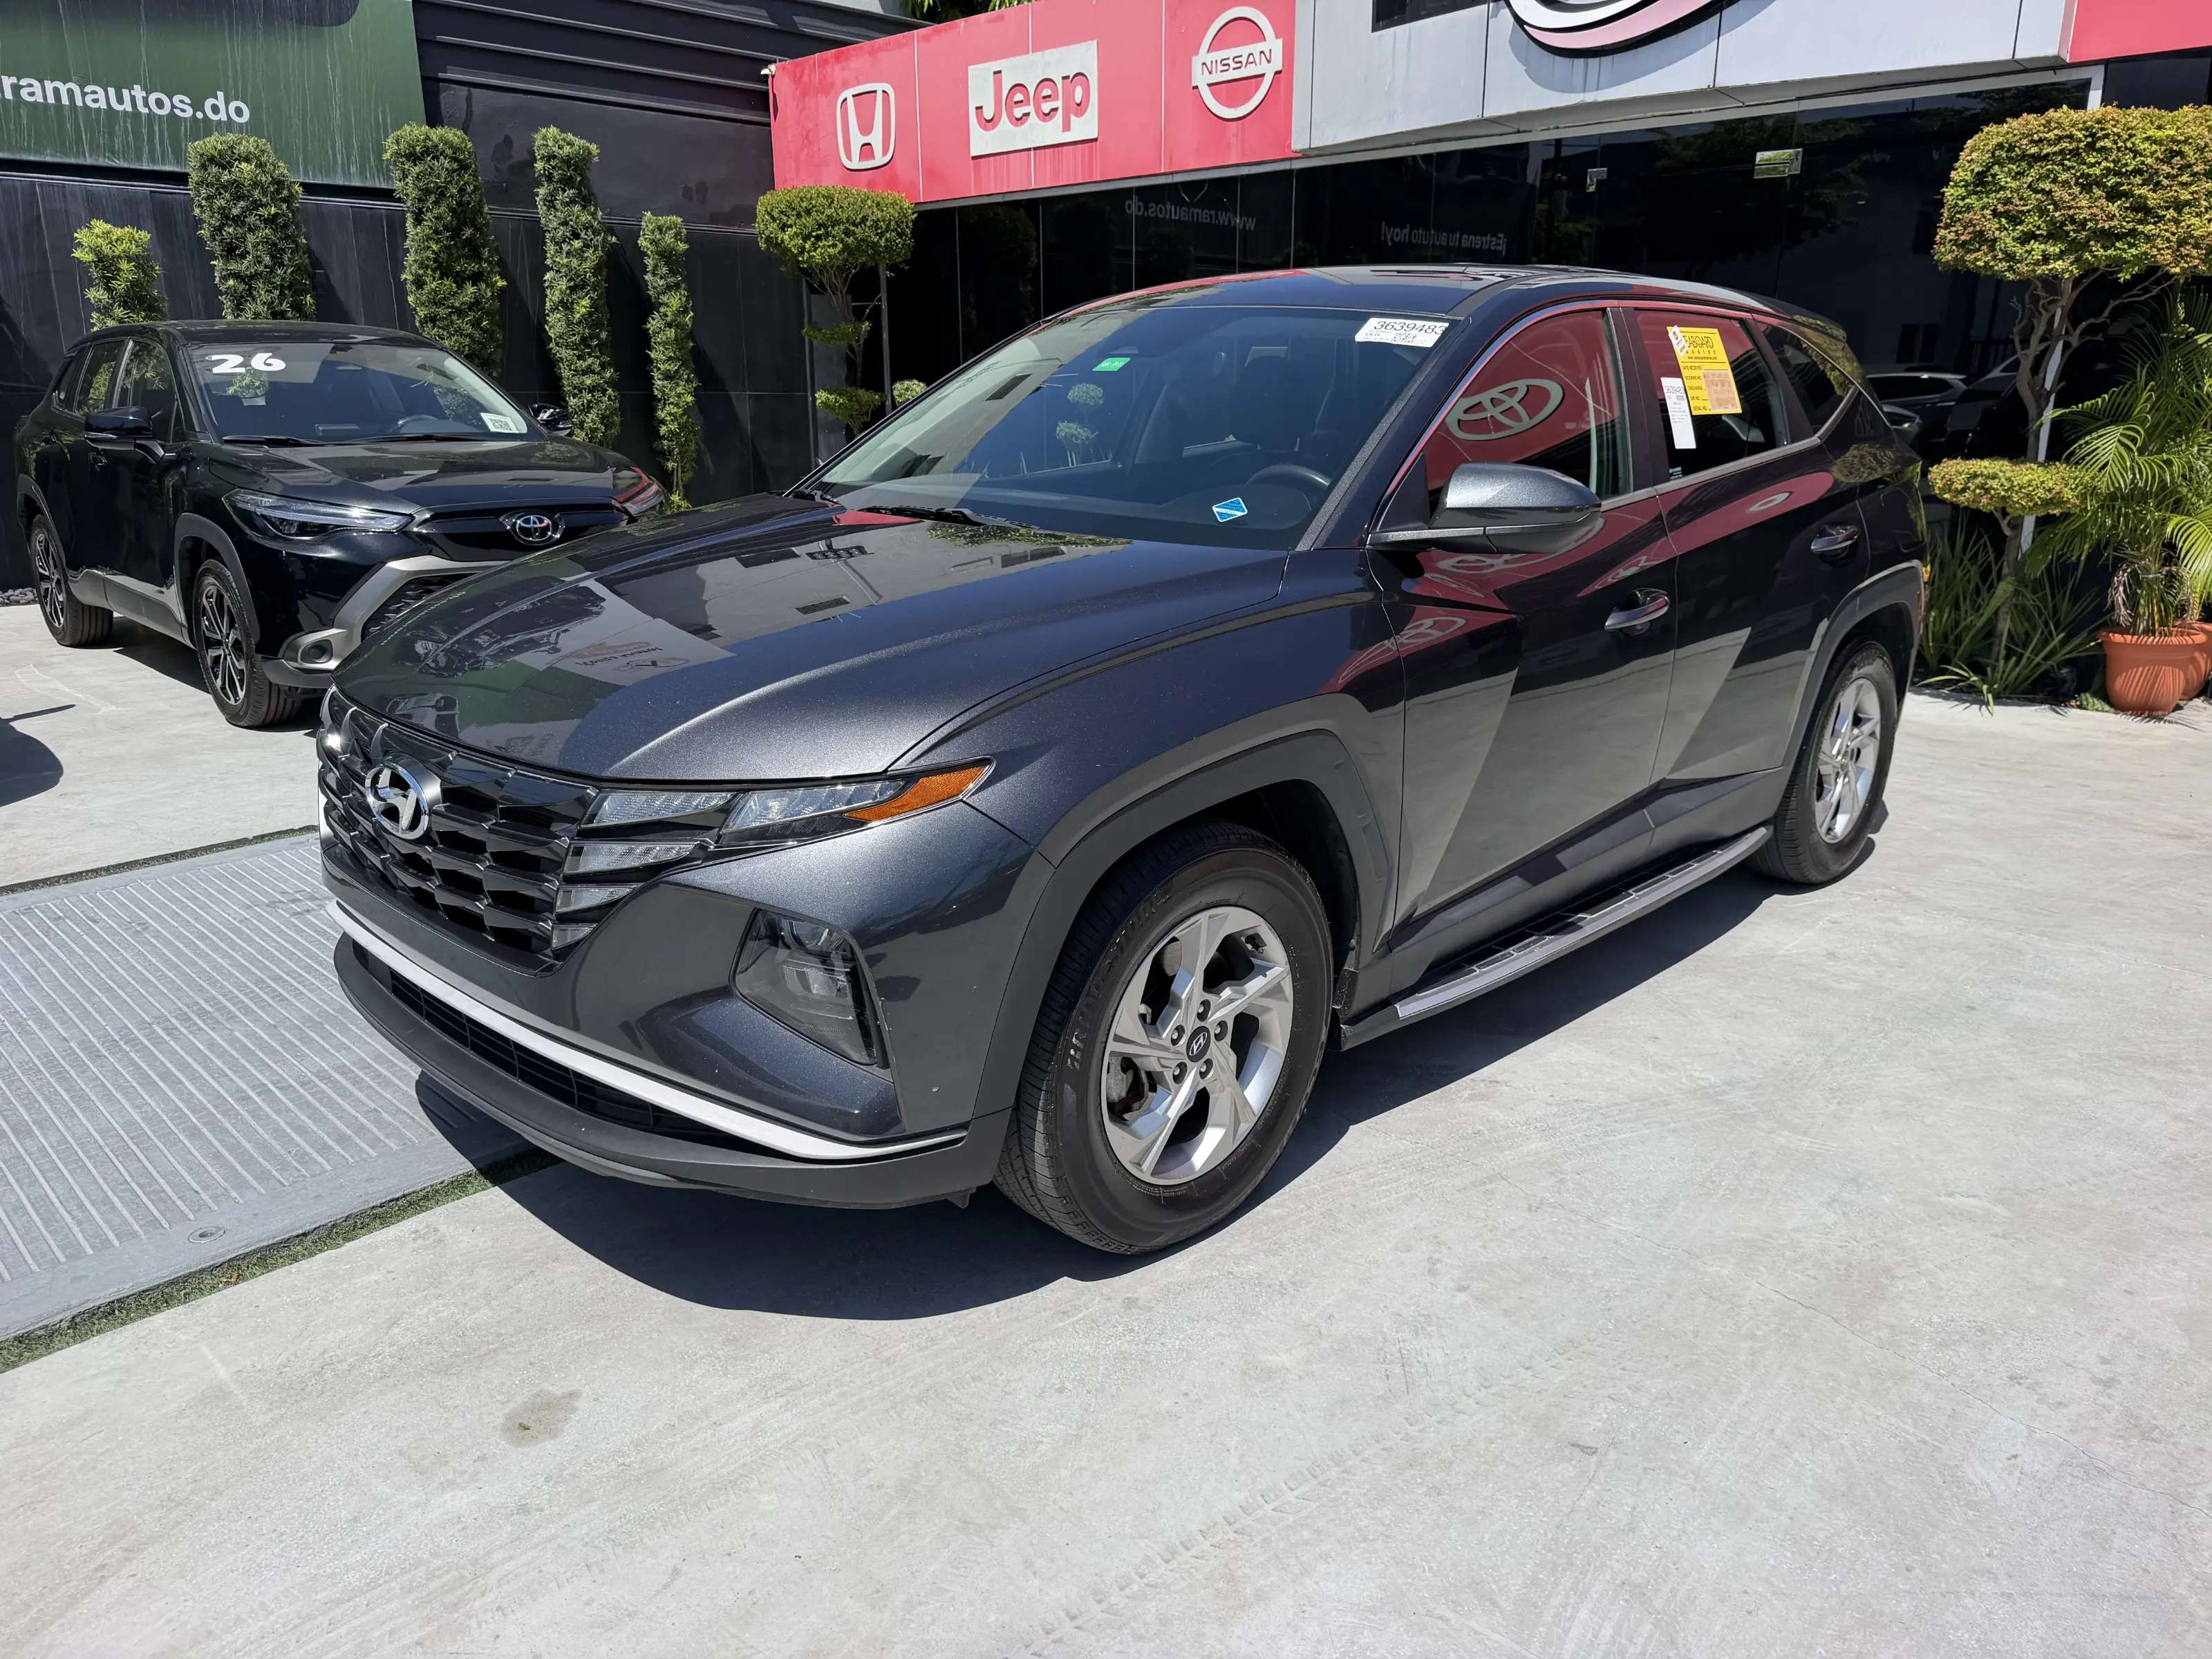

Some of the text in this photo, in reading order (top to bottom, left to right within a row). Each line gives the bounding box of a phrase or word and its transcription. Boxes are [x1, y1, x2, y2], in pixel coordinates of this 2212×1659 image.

[1201, 48, 1273, 77] NISSAN
[975, 70, 1091, 133] Jeep
[1374, 321, 1446, 335] 3639483
[207, 353, 286, 373] 26
